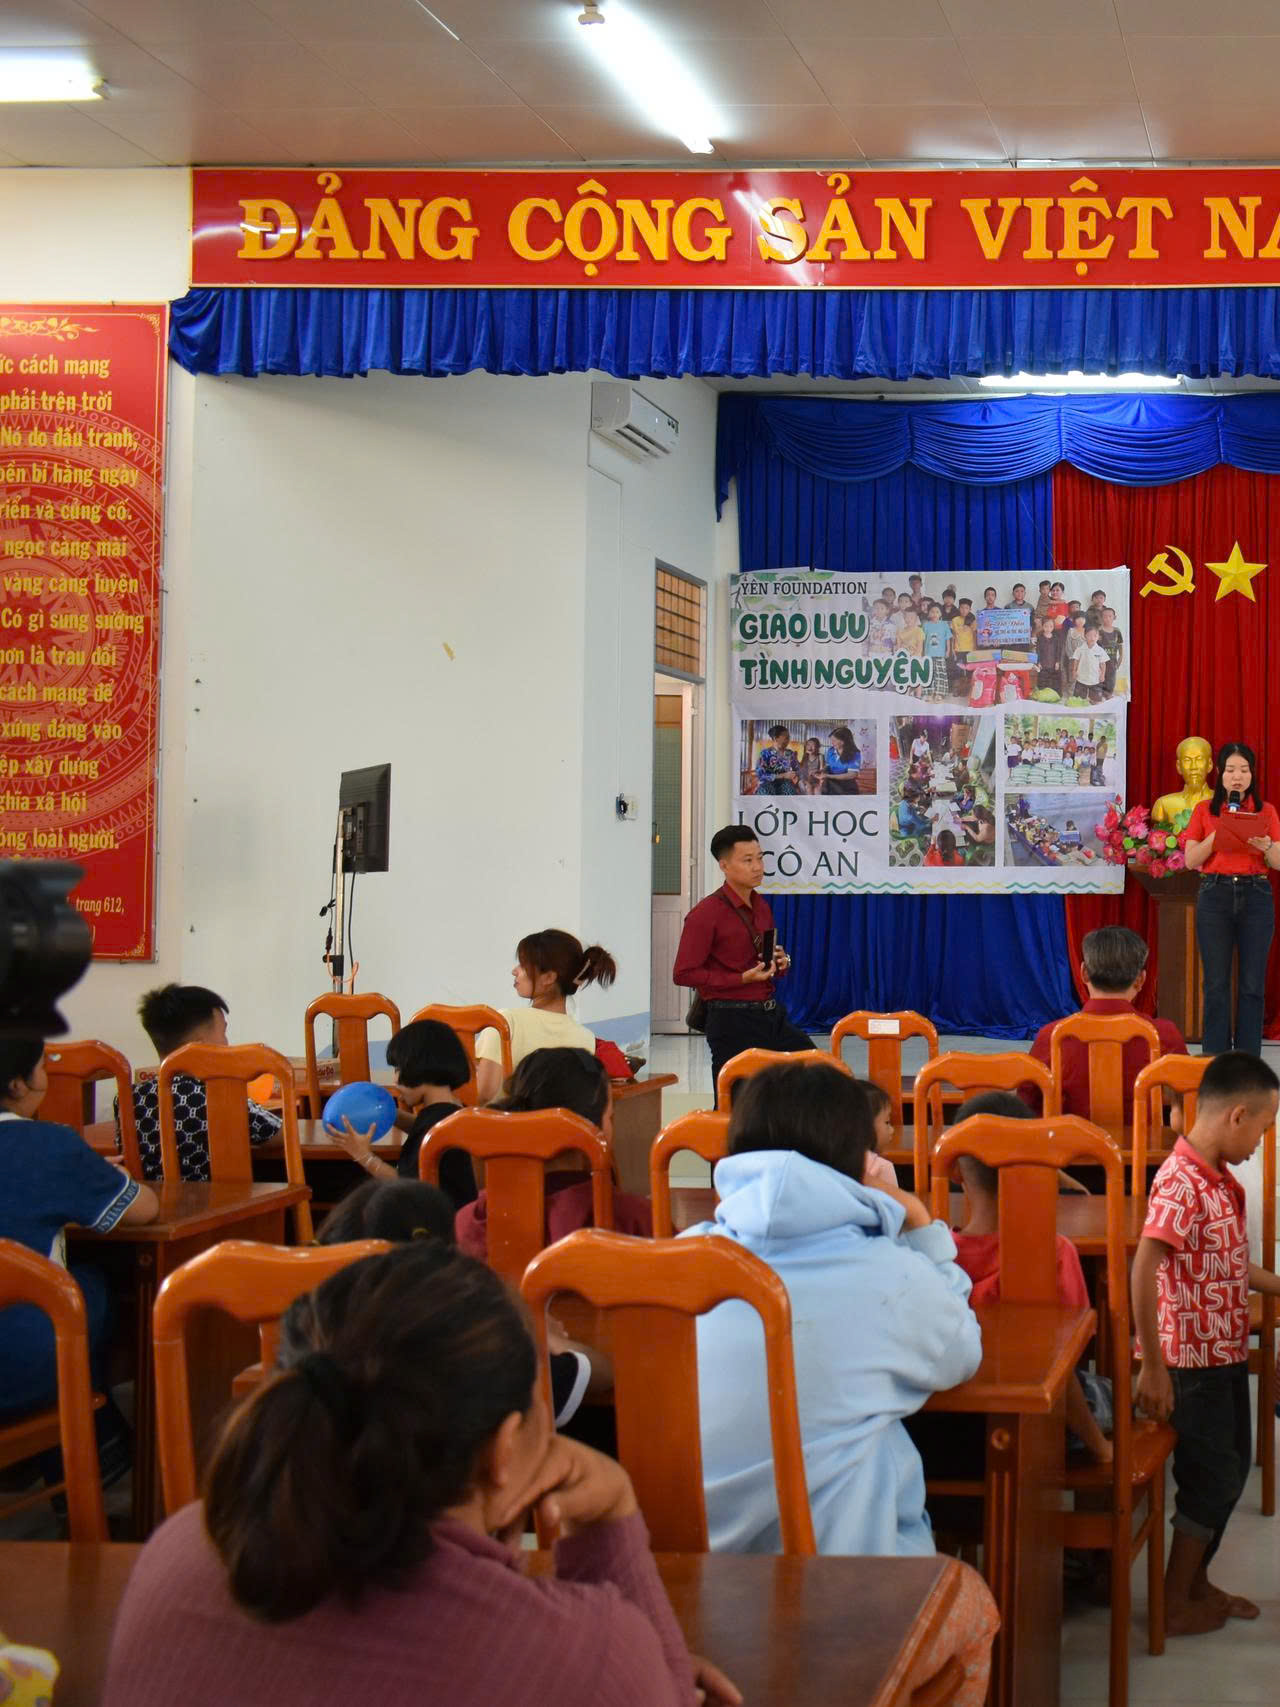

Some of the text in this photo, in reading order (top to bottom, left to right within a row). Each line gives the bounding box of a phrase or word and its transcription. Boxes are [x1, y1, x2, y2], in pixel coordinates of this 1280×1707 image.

[237, 172, 479, 261] ĐẢNG
[508, 178, 732, 277] CỘNG
[757, 172, 932, 262] SẢN
[961, 176, 1173, 276] VIỆT
[19, 353, 59, 375] cách
[64, 358, 111, 379] mạng
[0, 387, 112, 414] phải trên trời
[0, 421, 138, 451] Nó do đấu tranh,
[32, 460, 48, 484] bỉ
[53, 459, 94, 488] hằng
[99, 464, 139, 488] ngày
[35, 500, 54, 519] và
[60, 498, 101, 525] củng
[107, 498, 132, 520] cố.
[4, 539, 46, 560] ngọc
[49, 535, 91, 560] càng
[3, 571, 139, 598] vàng càng luyện
[741, 579, 867, 595] YÊN FOUNDATION
[1, 607, 145, 634] Có gì sung sướng
[739, 611, 868, 641] GIAO LƯU
[30, 644, 45, 664] là
[50, 646, 86, 665] trau
[739, 651, 931, 692] TÌNH NGUYỆN
[0, 678, 114, 706] cách mạng để
[1, 718, 122, 741] xứng đáng vào
[24, 755, 53, 778] xây
[59, 754, 100, 780] dựng
[36, 791, 55, 812] xã
[61, 791, 88, 816] hội
[32, 827, 63, 849] loài
[68, 830, 119, 852] người.
[808, 810, 879, 843] HỌC
[812, 851, 859, 877] AN
[75, 896, 125, 917] trang 612,
